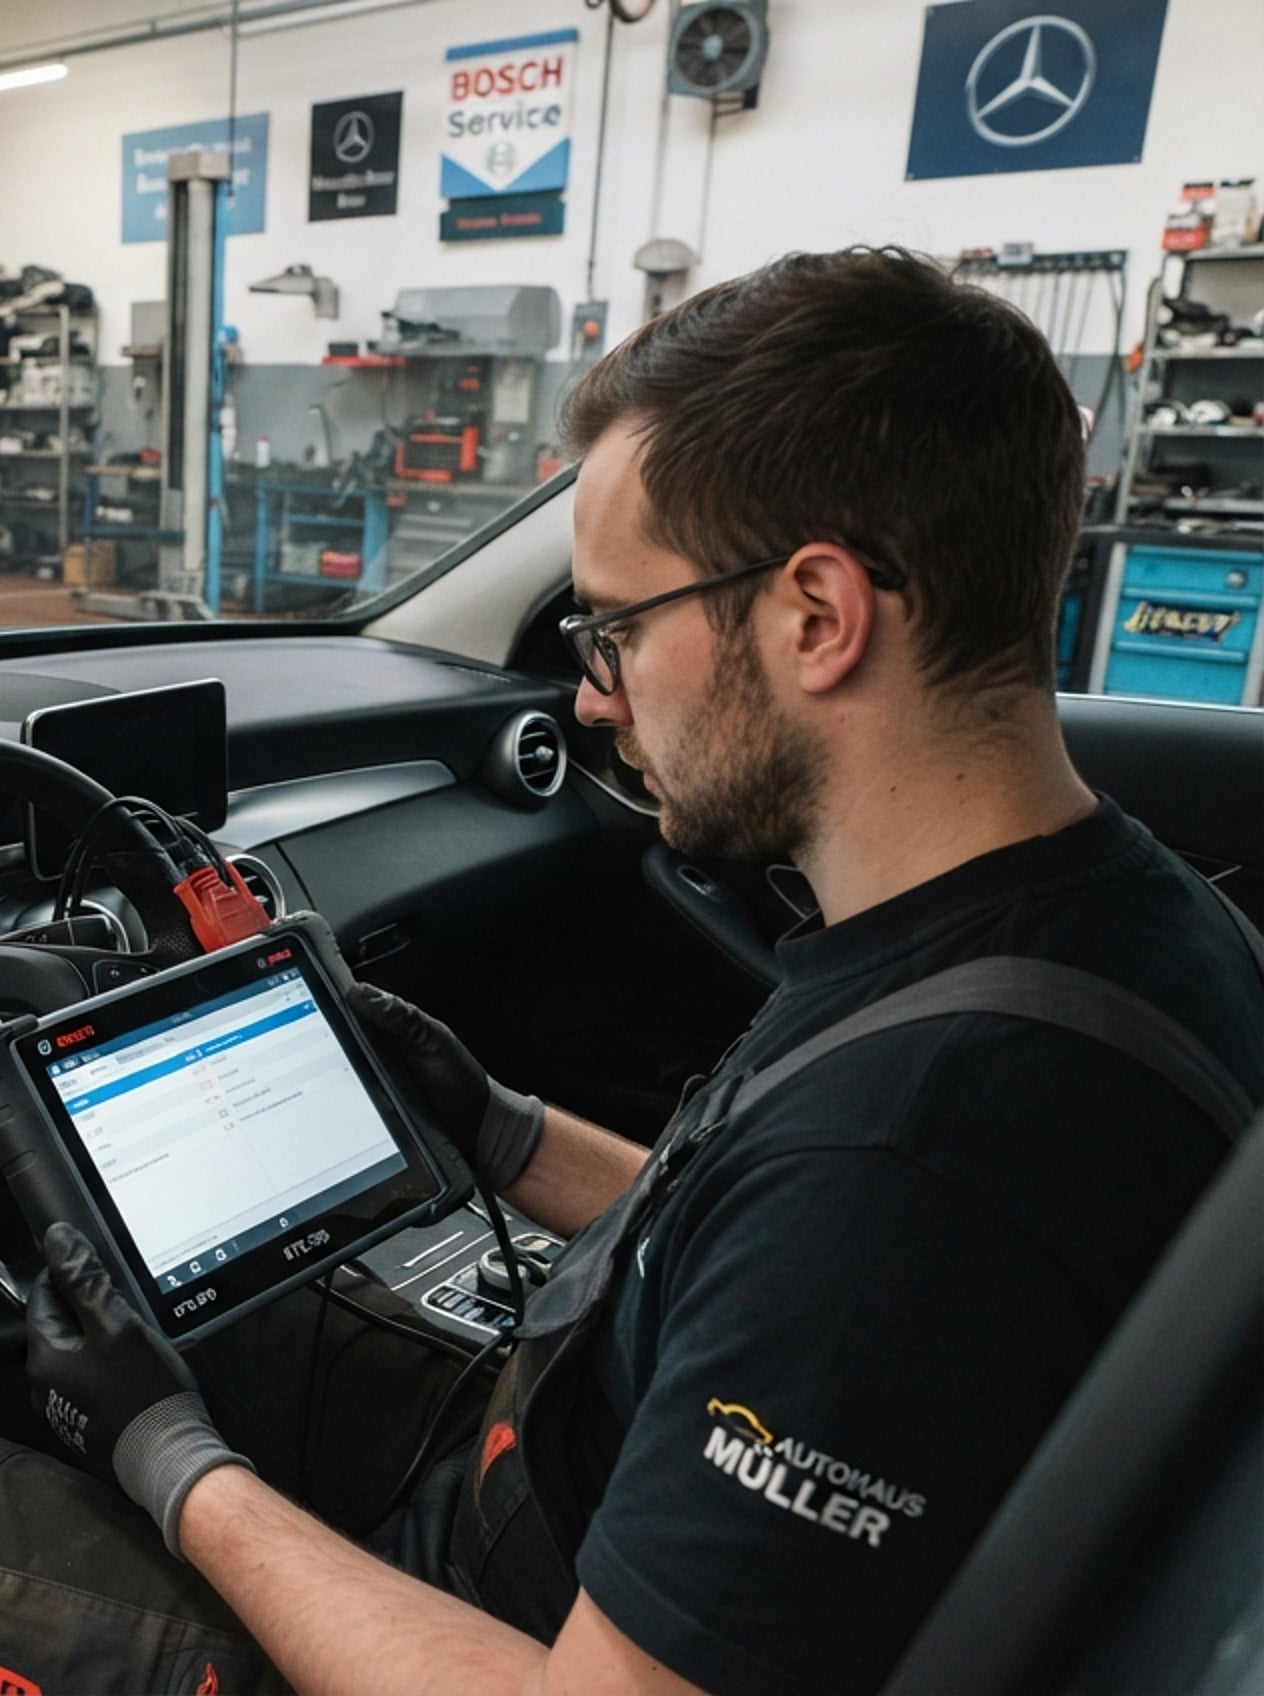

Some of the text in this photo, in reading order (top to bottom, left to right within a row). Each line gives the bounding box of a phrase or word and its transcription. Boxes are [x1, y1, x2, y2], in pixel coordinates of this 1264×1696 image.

[451, 57, 564, 101] BOSCH
[448, 102, 562, 138] Service
[703, 1426, 891, 1547] MÜLLER
[774, 1437, 927, 1518] AUTOHAUS
